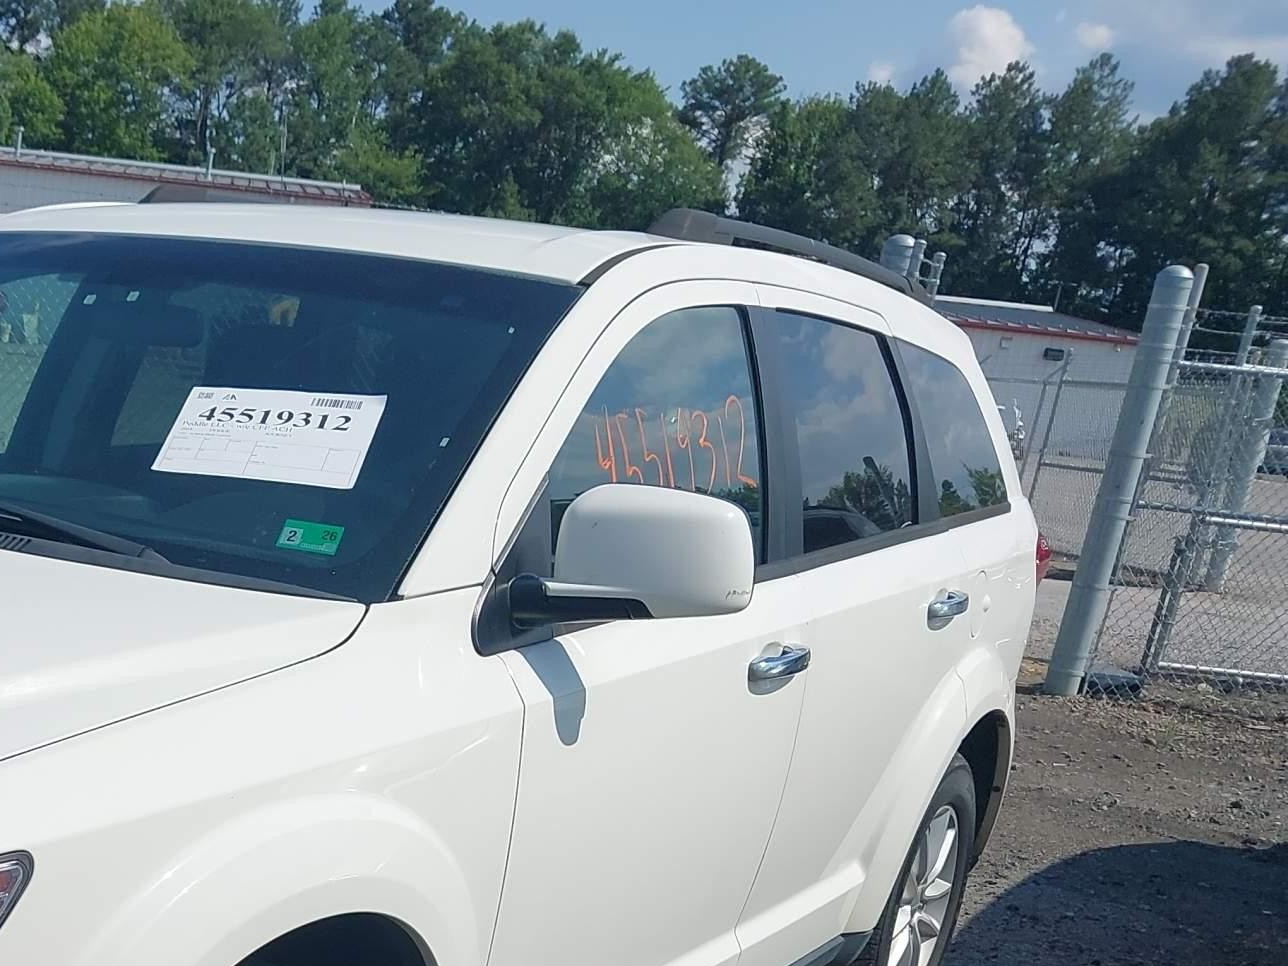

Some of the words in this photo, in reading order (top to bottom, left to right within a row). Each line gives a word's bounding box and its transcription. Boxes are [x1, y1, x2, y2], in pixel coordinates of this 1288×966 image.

[197, 405, 353, 432] 45519312
[594, 394, 757, 495] 45519312
[286, 530, 298, 542] 2
[321, 530, 338, 542] 26
